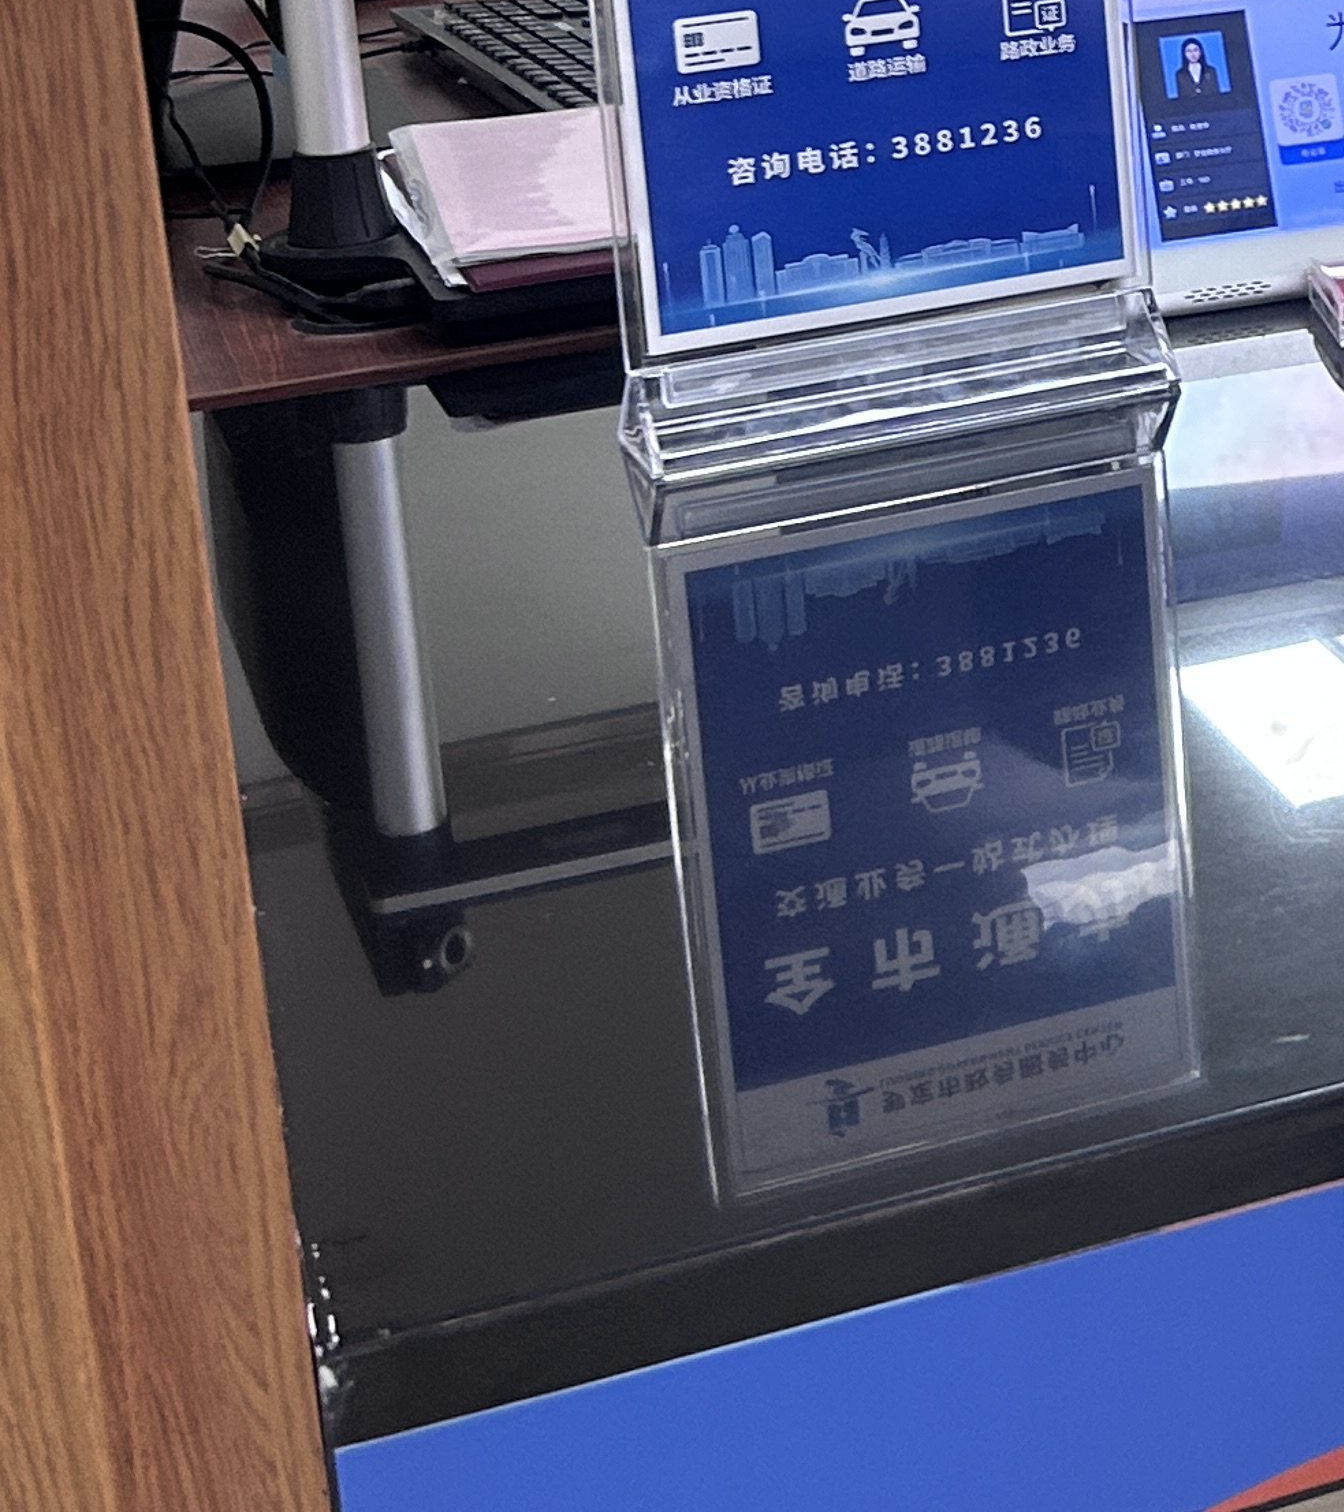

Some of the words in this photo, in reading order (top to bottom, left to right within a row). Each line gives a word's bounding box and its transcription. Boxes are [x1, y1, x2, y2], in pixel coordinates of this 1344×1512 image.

[1000, 34, 1076, 61] 路政业务
[847, 53, 928, 82] 道路运输
[672, 74, 775, 107] 从业资格证
